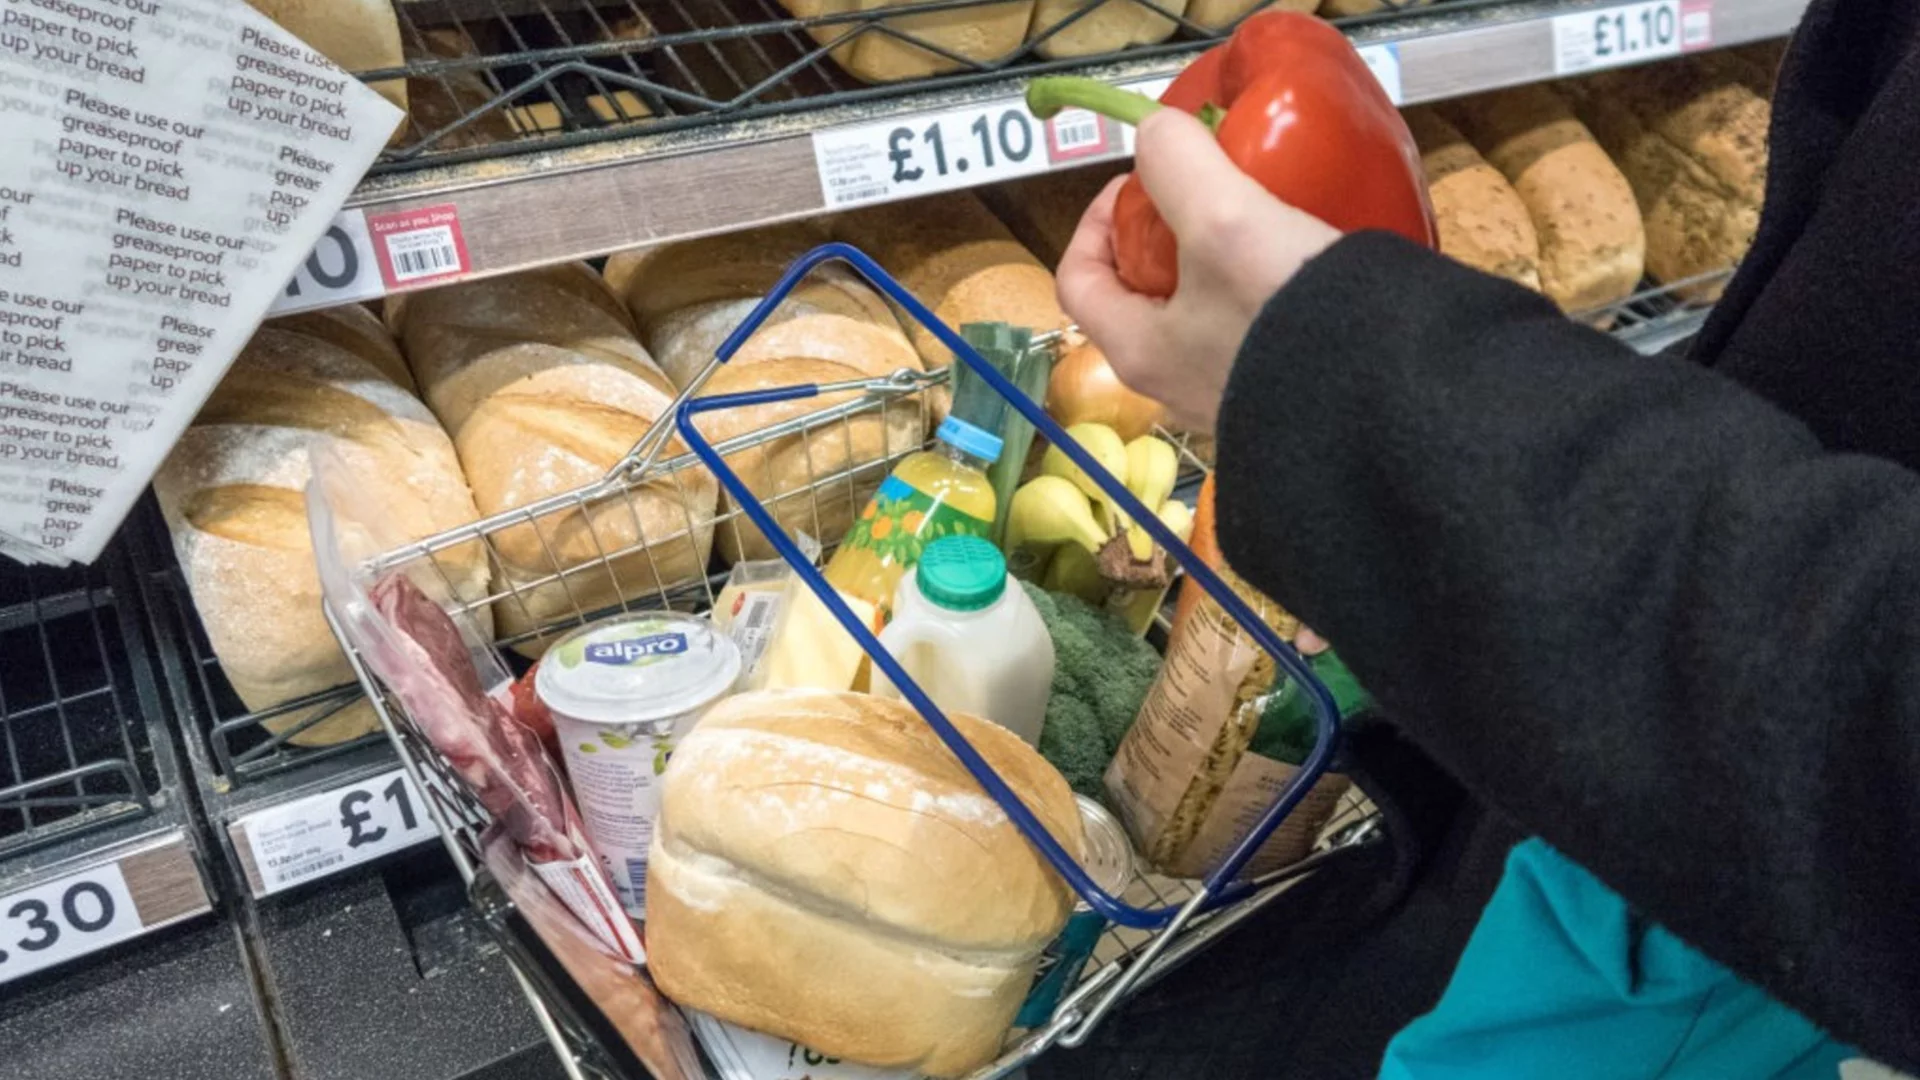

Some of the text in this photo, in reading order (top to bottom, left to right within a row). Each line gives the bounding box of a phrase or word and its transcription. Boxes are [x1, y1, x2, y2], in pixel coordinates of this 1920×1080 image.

[125, 0, 160, 16] our
[3, 9, 138, 59] paper to pick
[241, 27, 301, 60] Please
[1594, 5, 1674, 56] £1.10
[1, 32, 146, 84] up your bread
[236, 54, 348, 96] greaseproof
[66, 88, 131, 121] Please
[134, 112, 168, 132] use
[172, 122, 205, 139] our
[231, 75, 287, 99] paper
[289, 91, 308, 107] to
[310, 101, 348, 119] pick
[228, 96, 252, 115] up
[255, 105, 298, 125] your
[299, 113, 352, 141] bread
[62, 116, 184, 156] greaseproof
[889, 109, 1032, 183] £1.10
[58, 138, 118, 162] paper
[121, 151, 141, 168] to
[144, 158, 184, 179] pick
[0, 187, 34, 204] our
[56, 160, 83, 179] up
[85, 166, 131, 187] your
[134, 174, 190, 202] bread
[116, 208, 177, 236] Please
[180, 226, 212, 243] use
[215, 235, 245, 250] our
[267, 209, 290, 226] up
[113, 233, 225, 266] greaseproof
[109, 254, 226, 287] paper to pick
[13, 293, 48, 308] use
[51, 300, 84, 315] our
[106, 273, 131, 290] up
[134, 278, 177, 294] your
[179, 283, 231, 307] bread
[2, 330, 65, 352] to pick
[16, 350, 72, 372] bread
[0, 382, 60, 405] Please
[64, 395, 97, 410] use
[100, 400, 130, 414] our
[151, 375, 174, 391] up
[0, 405, 111, 430] greaseproof
[53, 430, 72, 444] to
[75, 435, 112, 449] pick
[20, 445, 63, 461] your
[66, 449, 119, 469] bread
[42, 534, 65, 549] up
[594, 637, 679, 660] alpro
